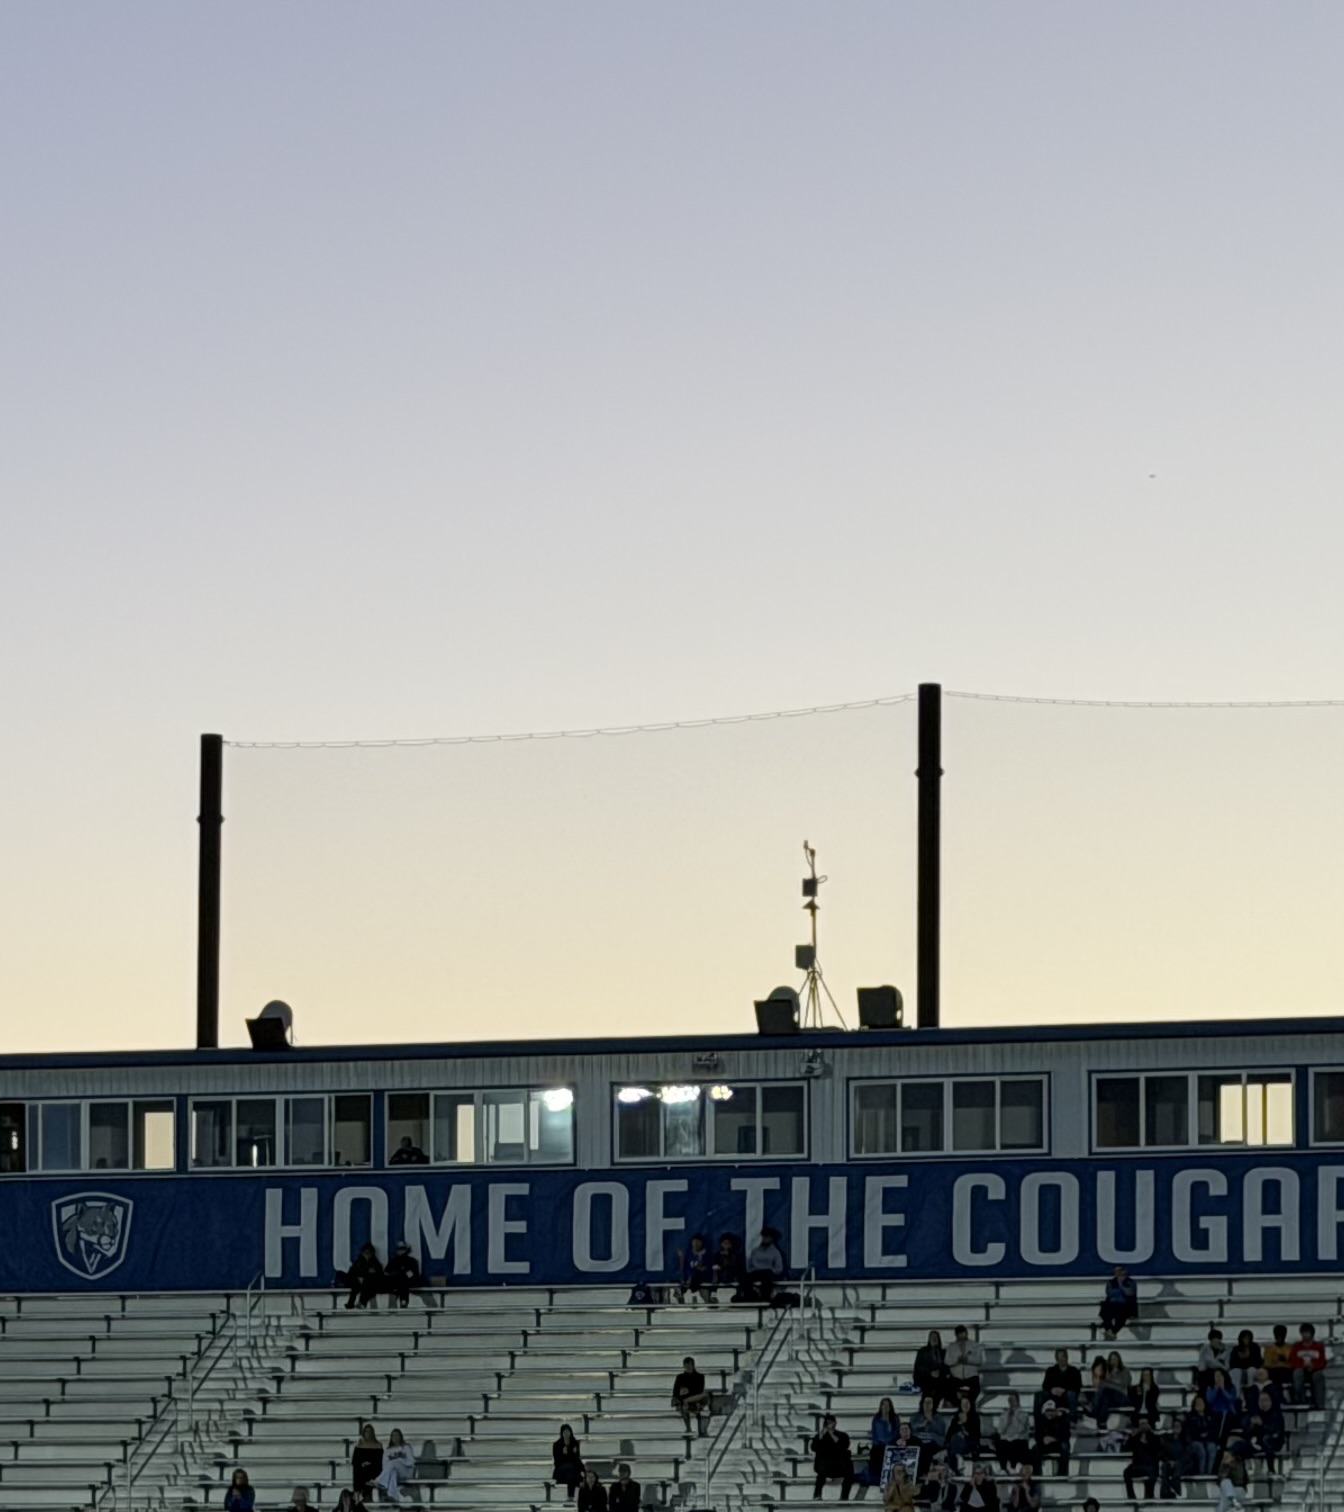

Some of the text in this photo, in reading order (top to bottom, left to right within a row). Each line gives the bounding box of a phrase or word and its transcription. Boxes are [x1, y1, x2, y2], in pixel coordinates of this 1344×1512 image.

[264, 1182, 530, 1278] HOME
[571, 1180, 689, 1273] OF
[731, 1176, 908, 1271] THE
